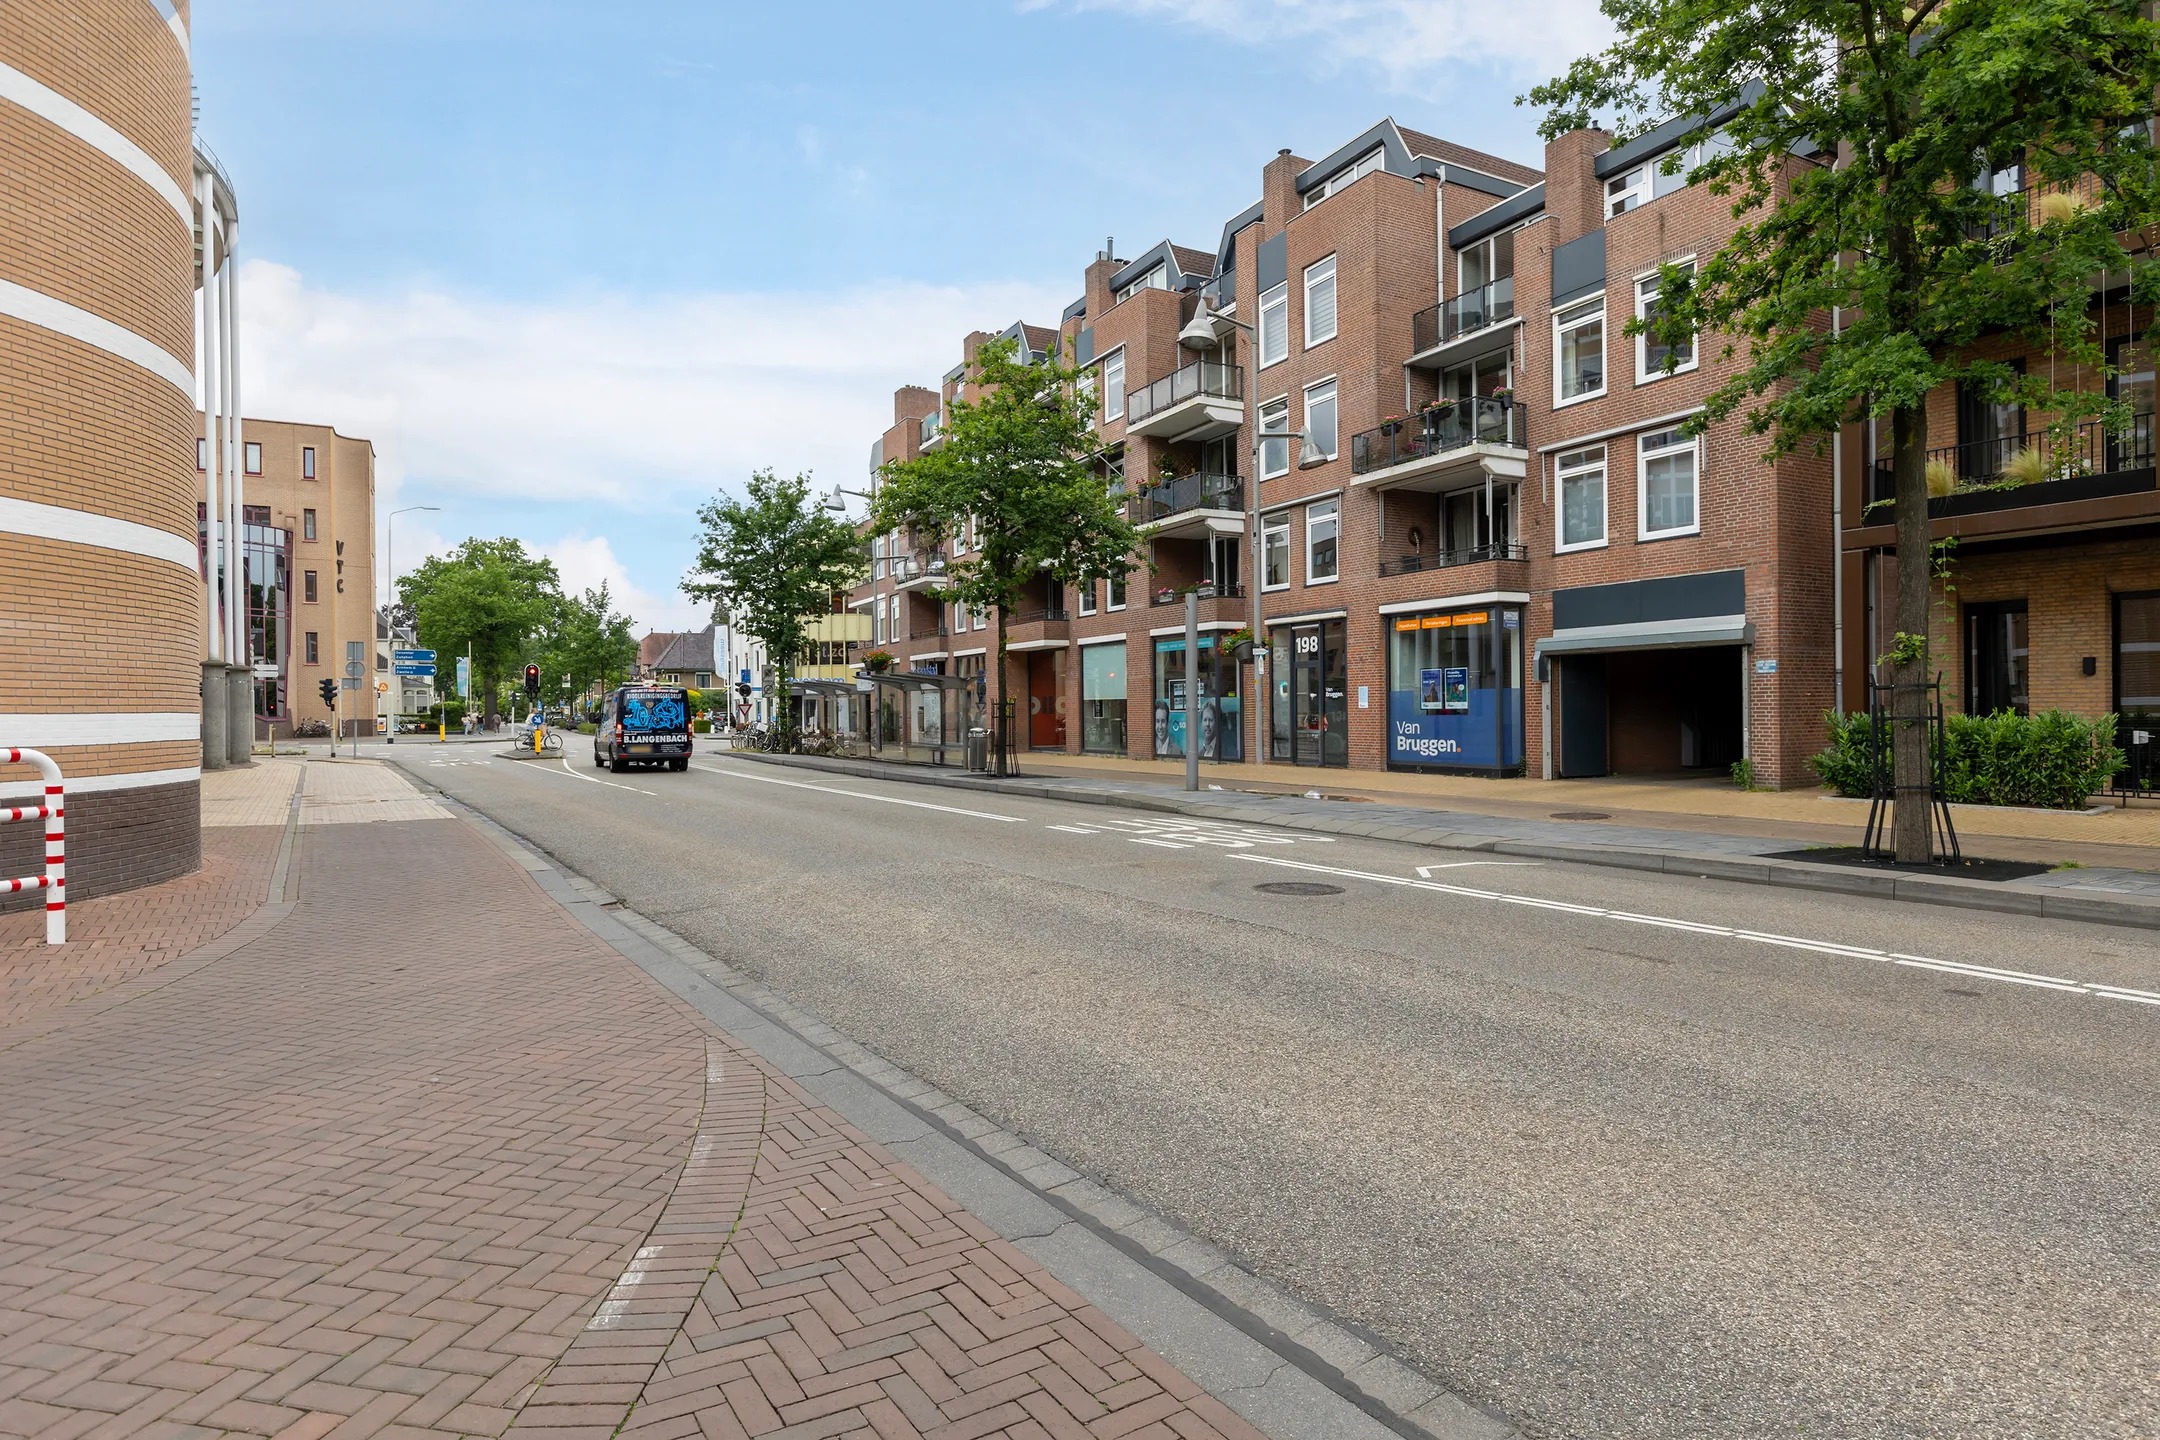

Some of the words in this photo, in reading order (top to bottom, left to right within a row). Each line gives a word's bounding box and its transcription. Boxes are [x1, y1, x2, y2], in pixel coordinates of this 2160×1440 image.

[336, 540, 344, 594] VTC
[1296, 635, 1319, 654] 198
[1396, 721, 1421, 735] Van
[1396, 736, 1462, 756] Bruggen.
[1156, 828, 1336, 848] BUS
